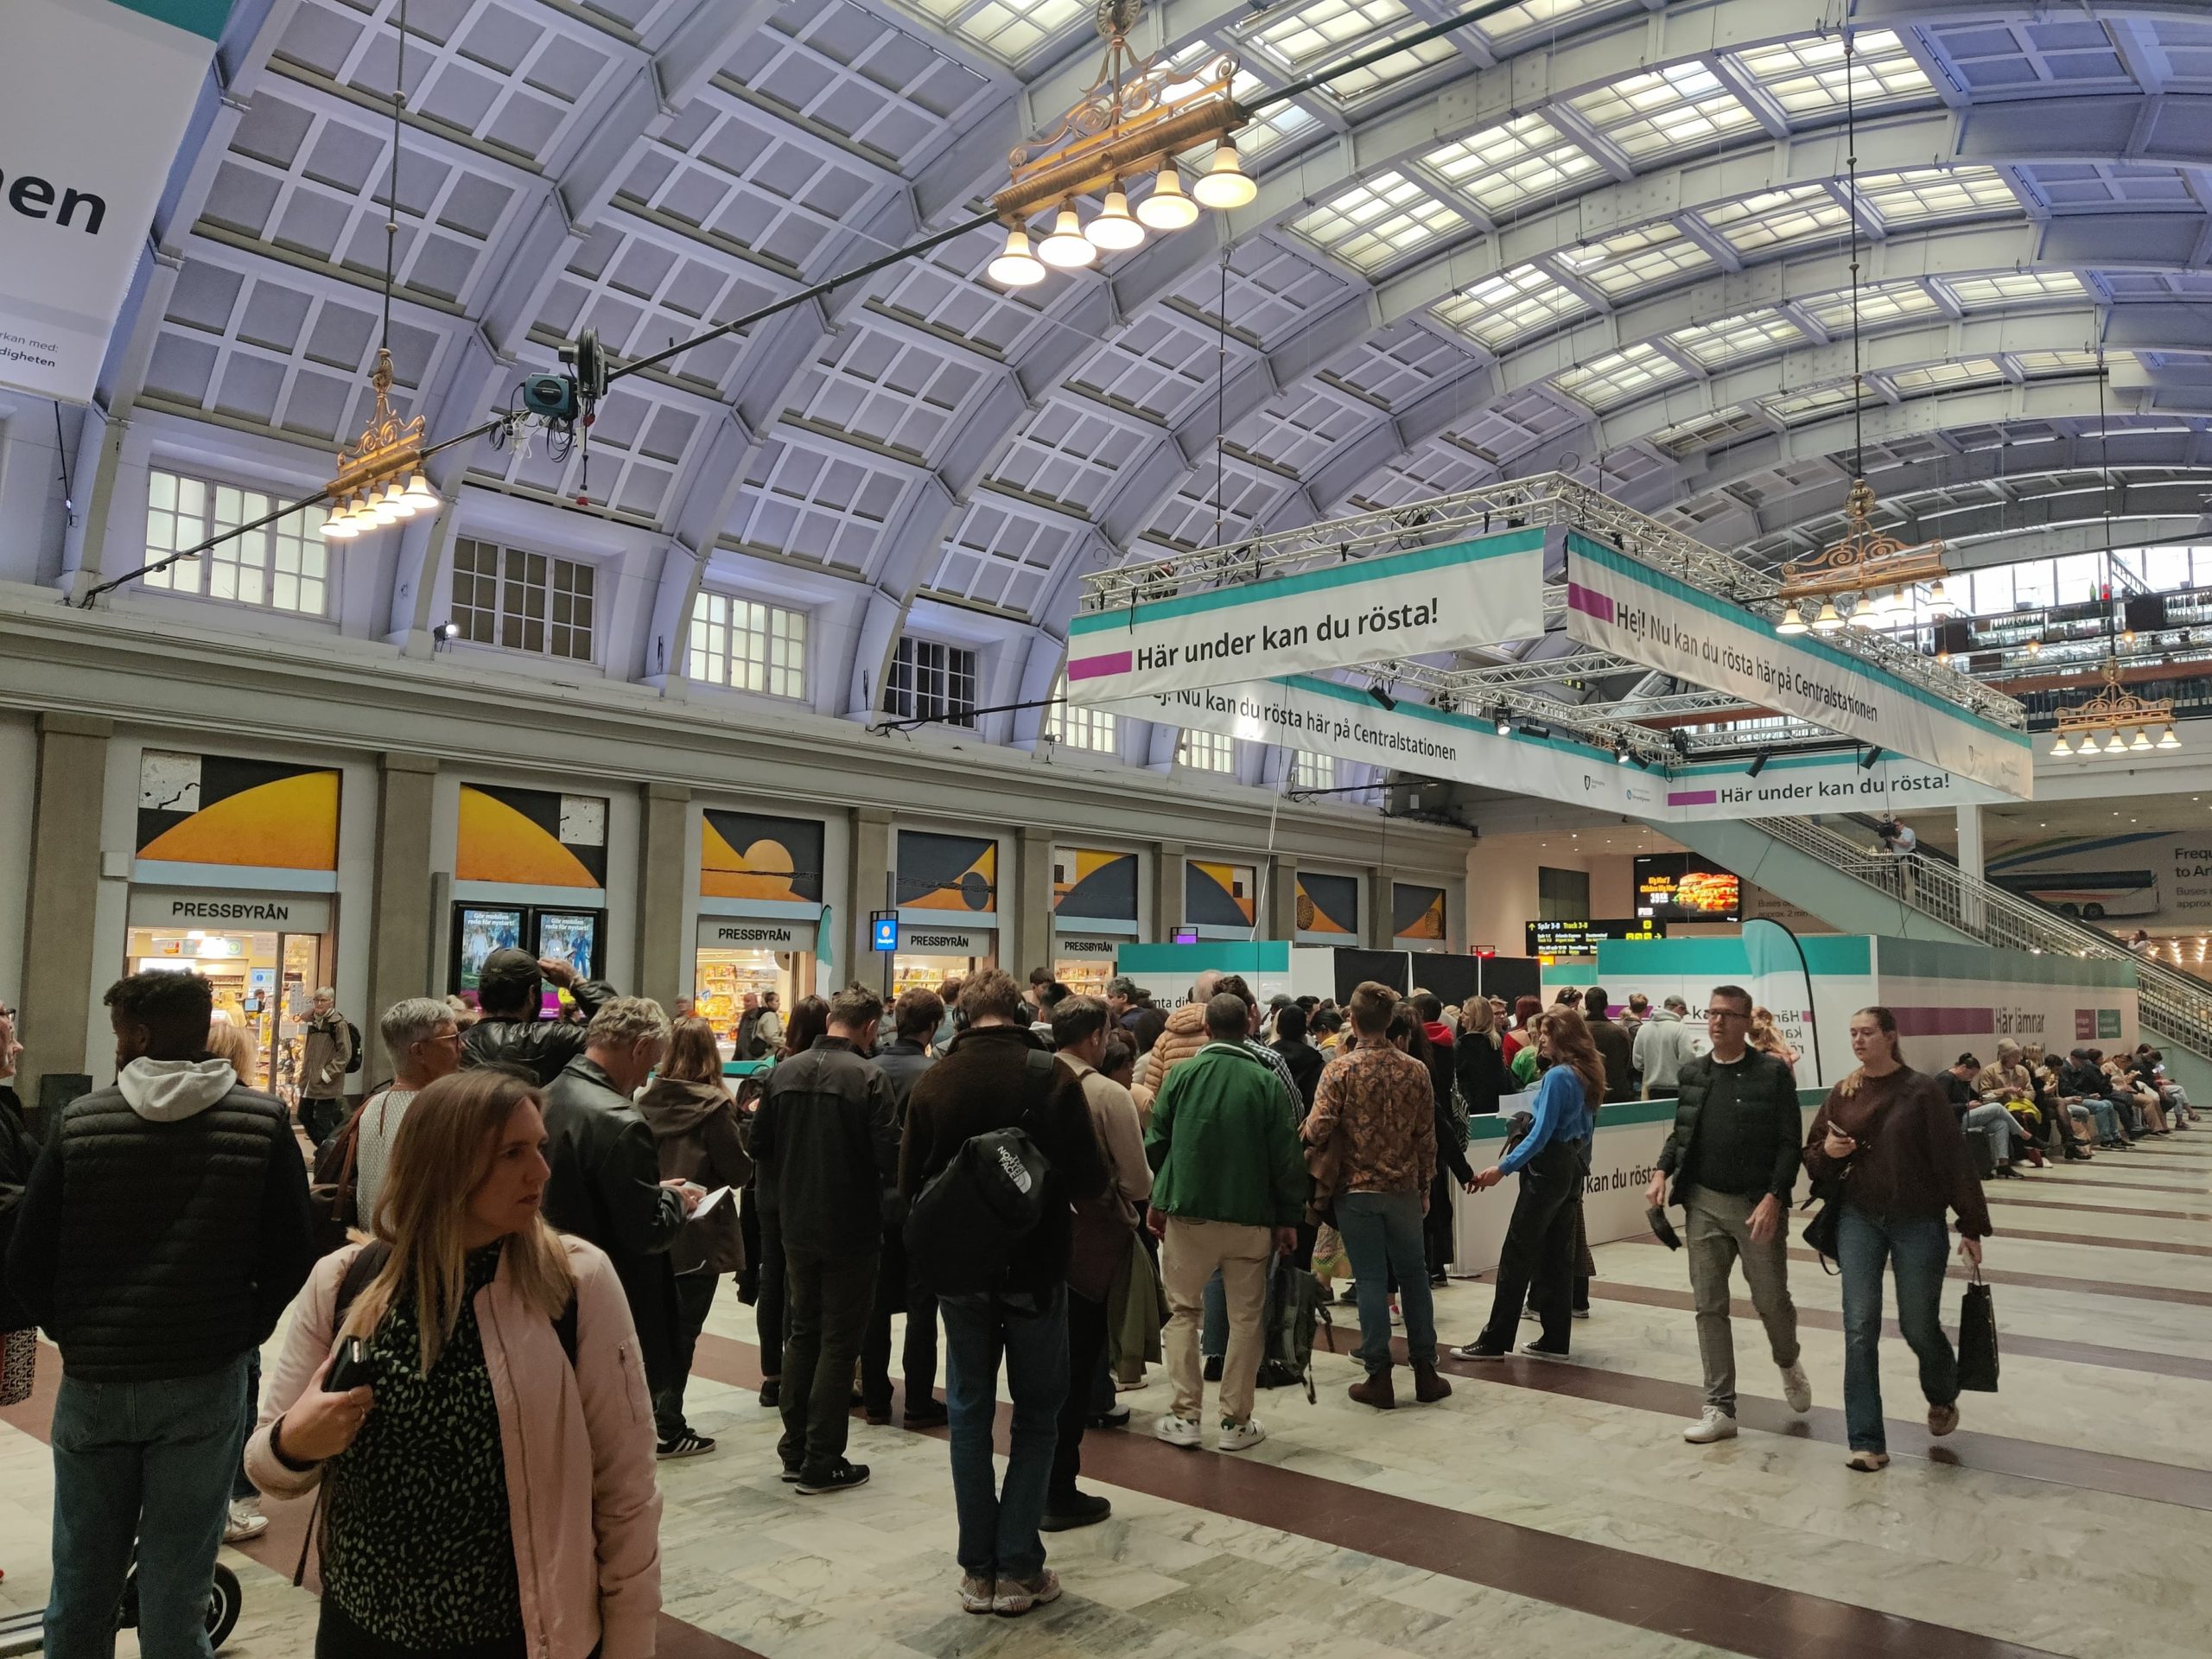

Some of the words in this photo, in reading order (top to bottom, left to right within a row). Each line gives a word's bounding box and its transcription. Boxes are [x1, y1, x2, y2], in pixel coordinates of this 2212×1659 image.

[0, 168, 106, 235] en
[29, 340, 59, 353] med:
[1137, 645, 1179, 671] Här
[1185, 632, 1255, 664] under
[1262, 625, 1308, 651] kan
[1317, 614, 1350, 641] du
[1358, 597, 1438, 635] rösta!
[1617, 601, 1645, 643] Hej!
[1650, 615, 1670, 645] Nu
[1674, 623, 1698, 657] kan
[1702, 637, 1719, 664] du
[1722, 646, 1753, 677] rösta
[1757, 657, 1777, 685] här
[1778, 666, 1792, 694] på
[1795, 673, 1878, 722] Centralstationen
[1177, 690, 1200, 708] Nu
[1206, 689, 1236, 715] kan
[1240, 696, 1261, 720] du
[1264, 704, 1302, 728] rösta
[1306, 710, 1331, 735] här
[1334, 718, 1351, 741] på
[1354, 723, 1457, 761] Centralstationen
[1721, 787, 1753, 804] Här
[1758, 784, 1813, 801] under
[1819, 781, 1854, 797] kan
[1860, 778, 1885, 793] du
[1891, 772, 1950, 791] rösta!
[2175, 867, 2190, 878] to
[172, 901, 289, 920] PRESSBYRÅN
[718, 928, 791, 941] PRESSBYRÅN
[911, 935, 969, 947] PRESSBYRÅN
[1065, 941, 1113, 952] PRESSBYRÅN
[1153, 998, 1172, 1008] mta
[1175, 996, 1189, 1008] dit
[1995, 1007, 2013, 1034] Här
[2015, 1006, 2045, 1034] lämnar
[997, 1146, 1022, 1175] NORTH
[998, 1156, 1017, 1179] FACE
[1013, 1154, 1027, 1173] THE
[1586, 1174, 1609, 1194] kan
[1611, 1167, 1627, 1190] du
